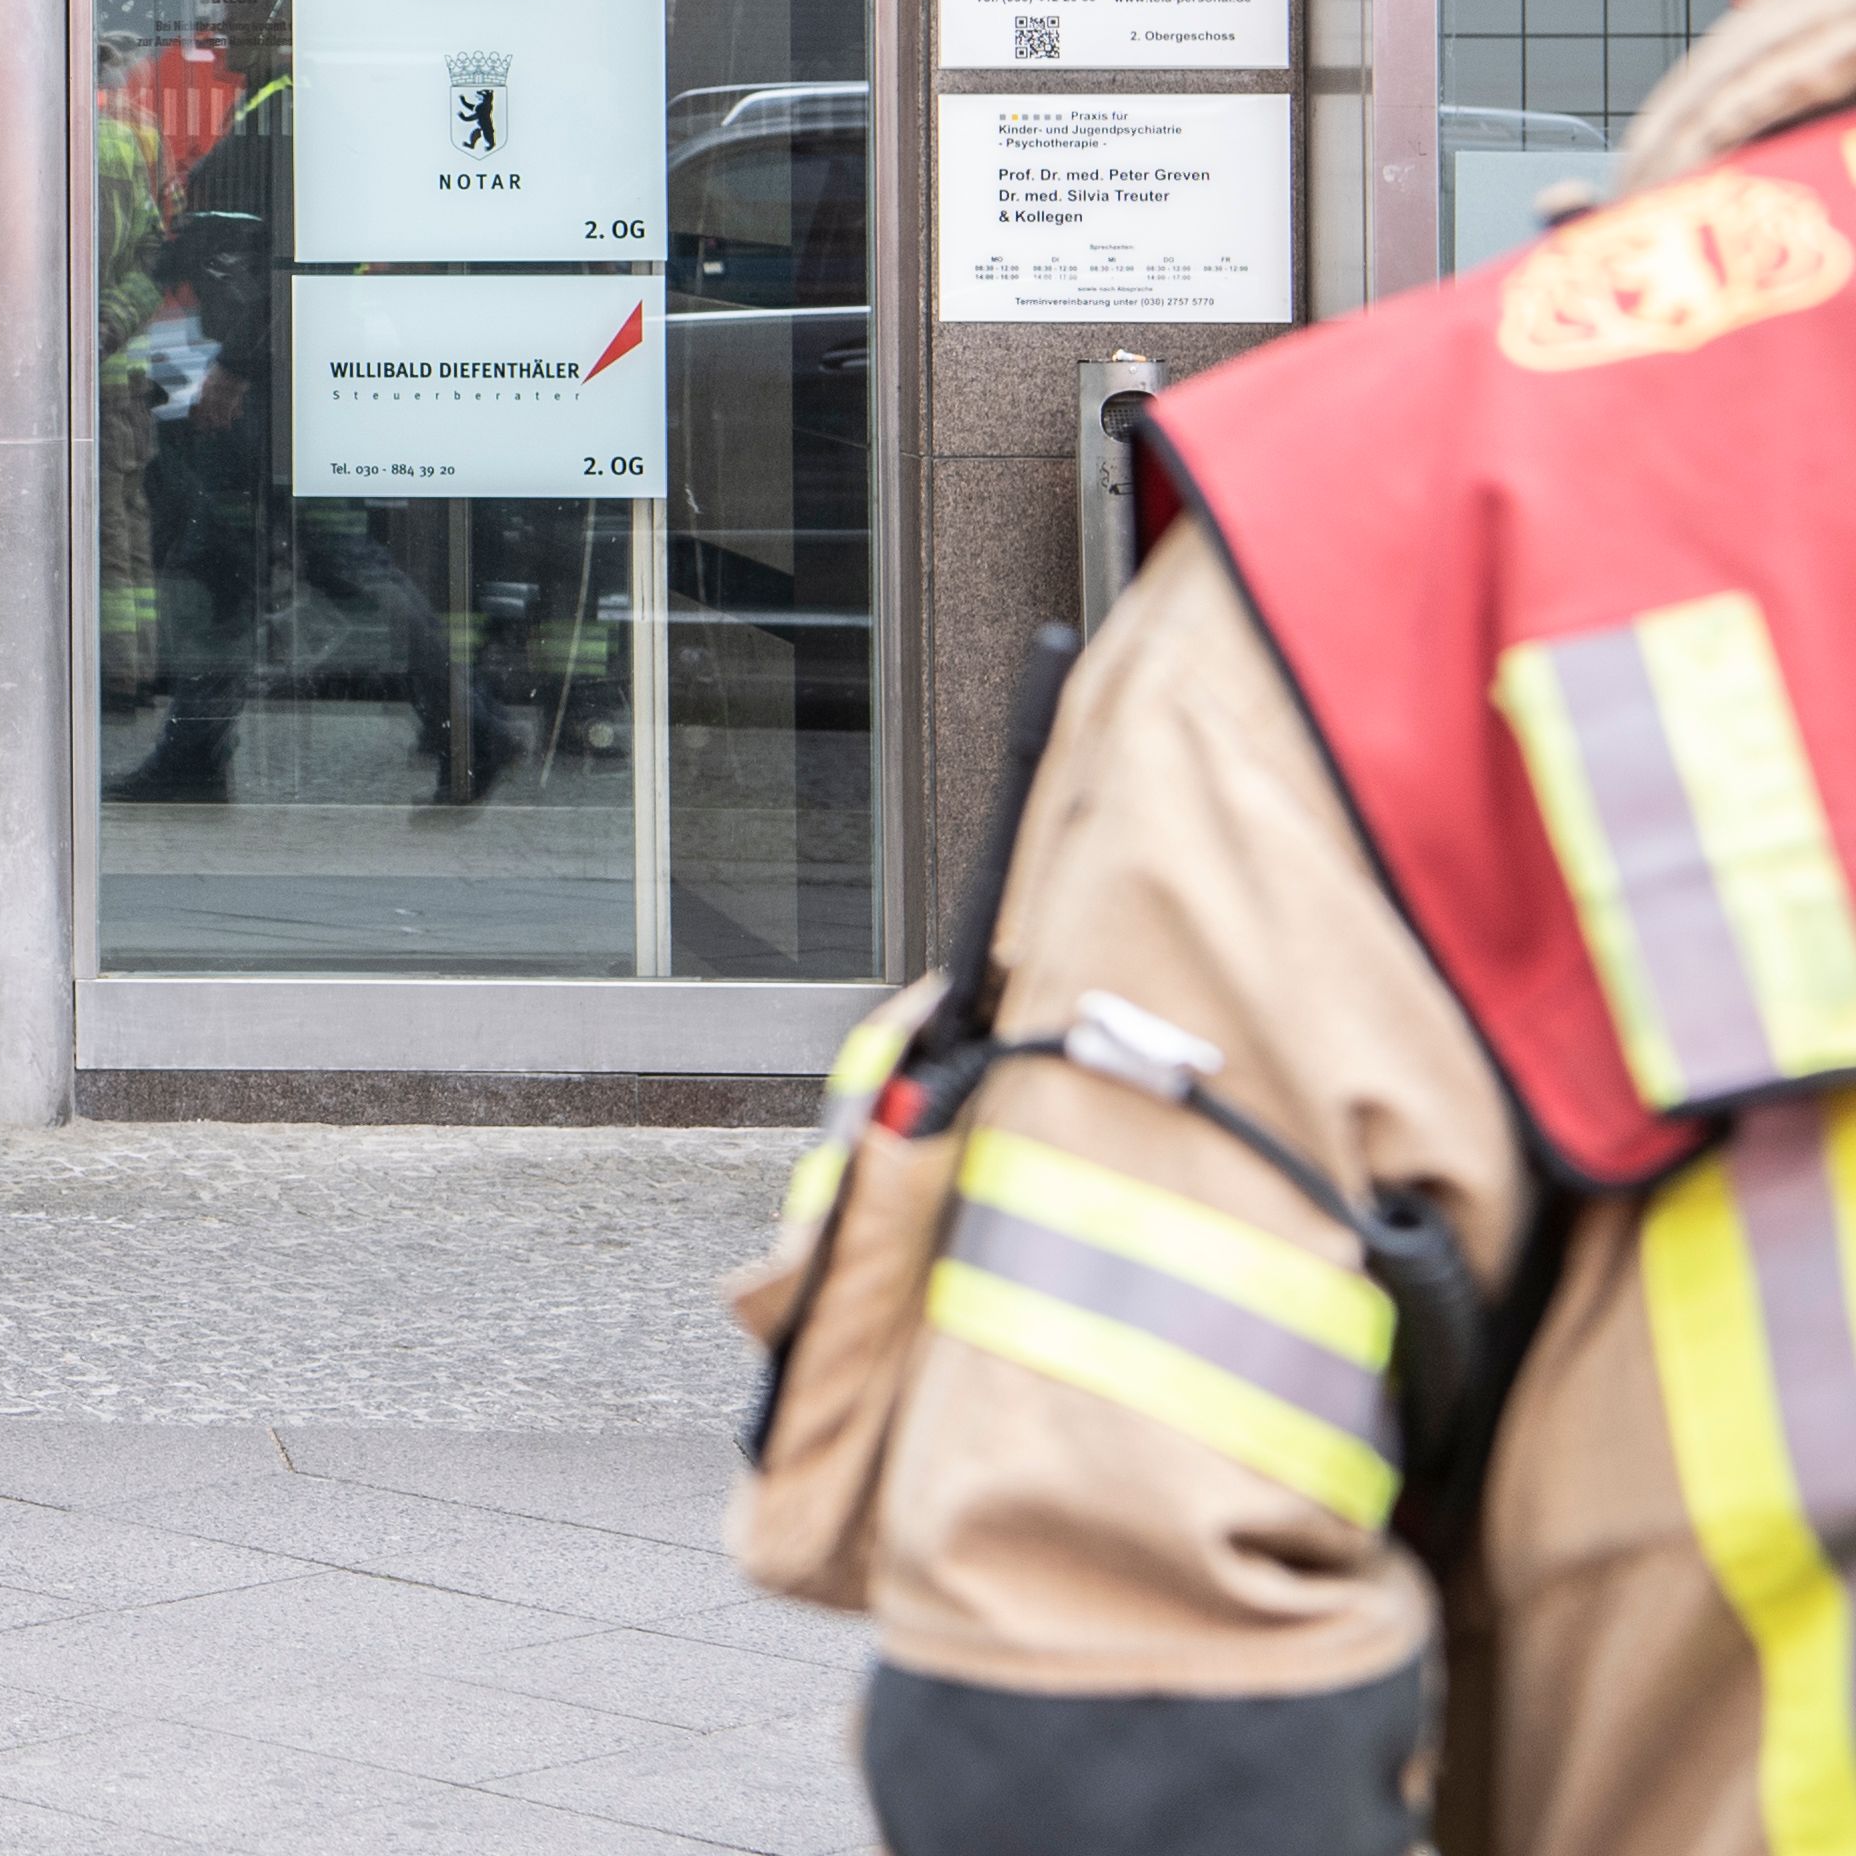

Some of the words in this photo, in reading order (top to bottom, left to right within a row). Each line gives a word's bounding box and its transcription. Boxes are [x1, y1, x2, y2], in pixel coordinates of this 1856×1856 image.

[1145, 31, 1236, 43] Obergeschoss
[439, 173, 522, 191] NOTAR
[998, 169, 1035, 182] Prof.
[1040, 169, 1061, 182] Dr.
[1067, 169, 1104, 182] med.
[1109, 169, 1149, 182] Peter
[1154, 169, 1210, 182] Greven
[998, 190, 1020, 203] Dr.
[1025, 189, 1063, 203] med.
[1067, 189, 1109, 203] Silvia
[1113, 190, 1170, 203] Treuter
[998, 211, 1010, 223] &
[1015, 210, 1084, 225] Kollegen
[584, 221, 605, 240] 2.
[611, 220, 646, 240] OG
[330, 361, 432, 380] WILLIBALD
[439, 358, 580, 380] DIEFENTHÄLER
[331, 463, 351, 475] Tel.
[355, 465, 379, 476] 030
[391, 464, 415, 478] 884
[419, 465, 435, 479] 39
[439, 465, 455, 476] 20
[583, 458, 604, 476] 2.
[610, 456, 645, 476] OG
